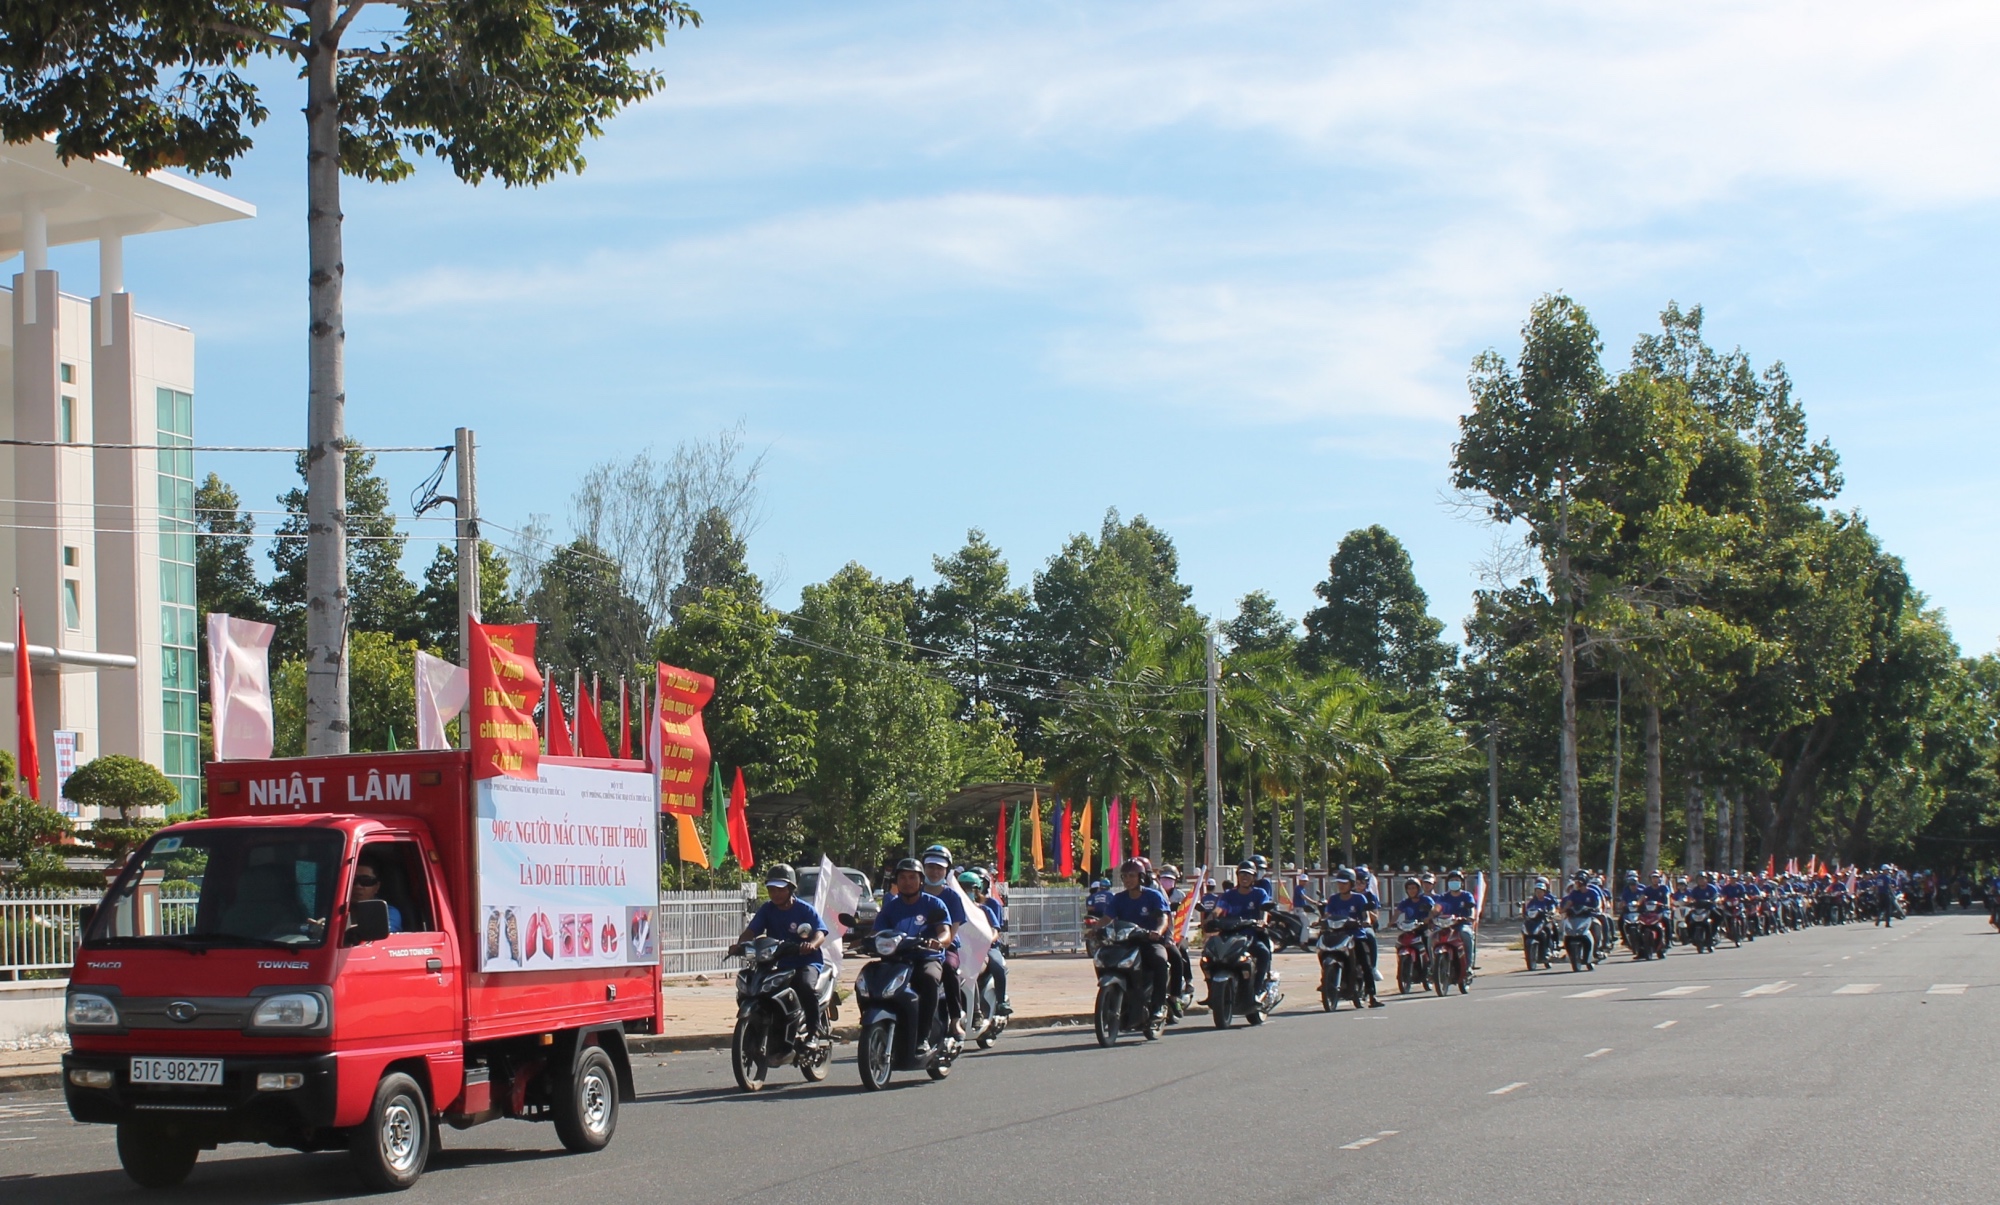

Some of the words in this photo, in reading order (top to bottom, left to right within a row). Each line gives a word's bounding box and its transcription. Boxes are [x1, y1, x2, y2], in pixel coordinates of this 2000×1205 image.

[249, 772, 325, 810] NHẬT
[347, 768, 411, 802] LÂM
[492, 819, 513, 842] 90%
[515, 816, 551, 845] NGƯỜI
[554, 812, 575, 846] MẮC
[578, 825, 599, 847] UNG
[601, 825, 622, 848] THƯ
[624, 816, 648, 849] PHỔI
[520, 856, 533, 886] LÀ
[536, 863, 551, 886] DO
[554, 858, 576, 887] HÚT
[578, 854, 611, 887] THUỐC
[614, 859, 626, 887] LÁ
[257, 961, 309, 969] TOWNER
[133, 1060, 219, 1082] 51C-982.77
